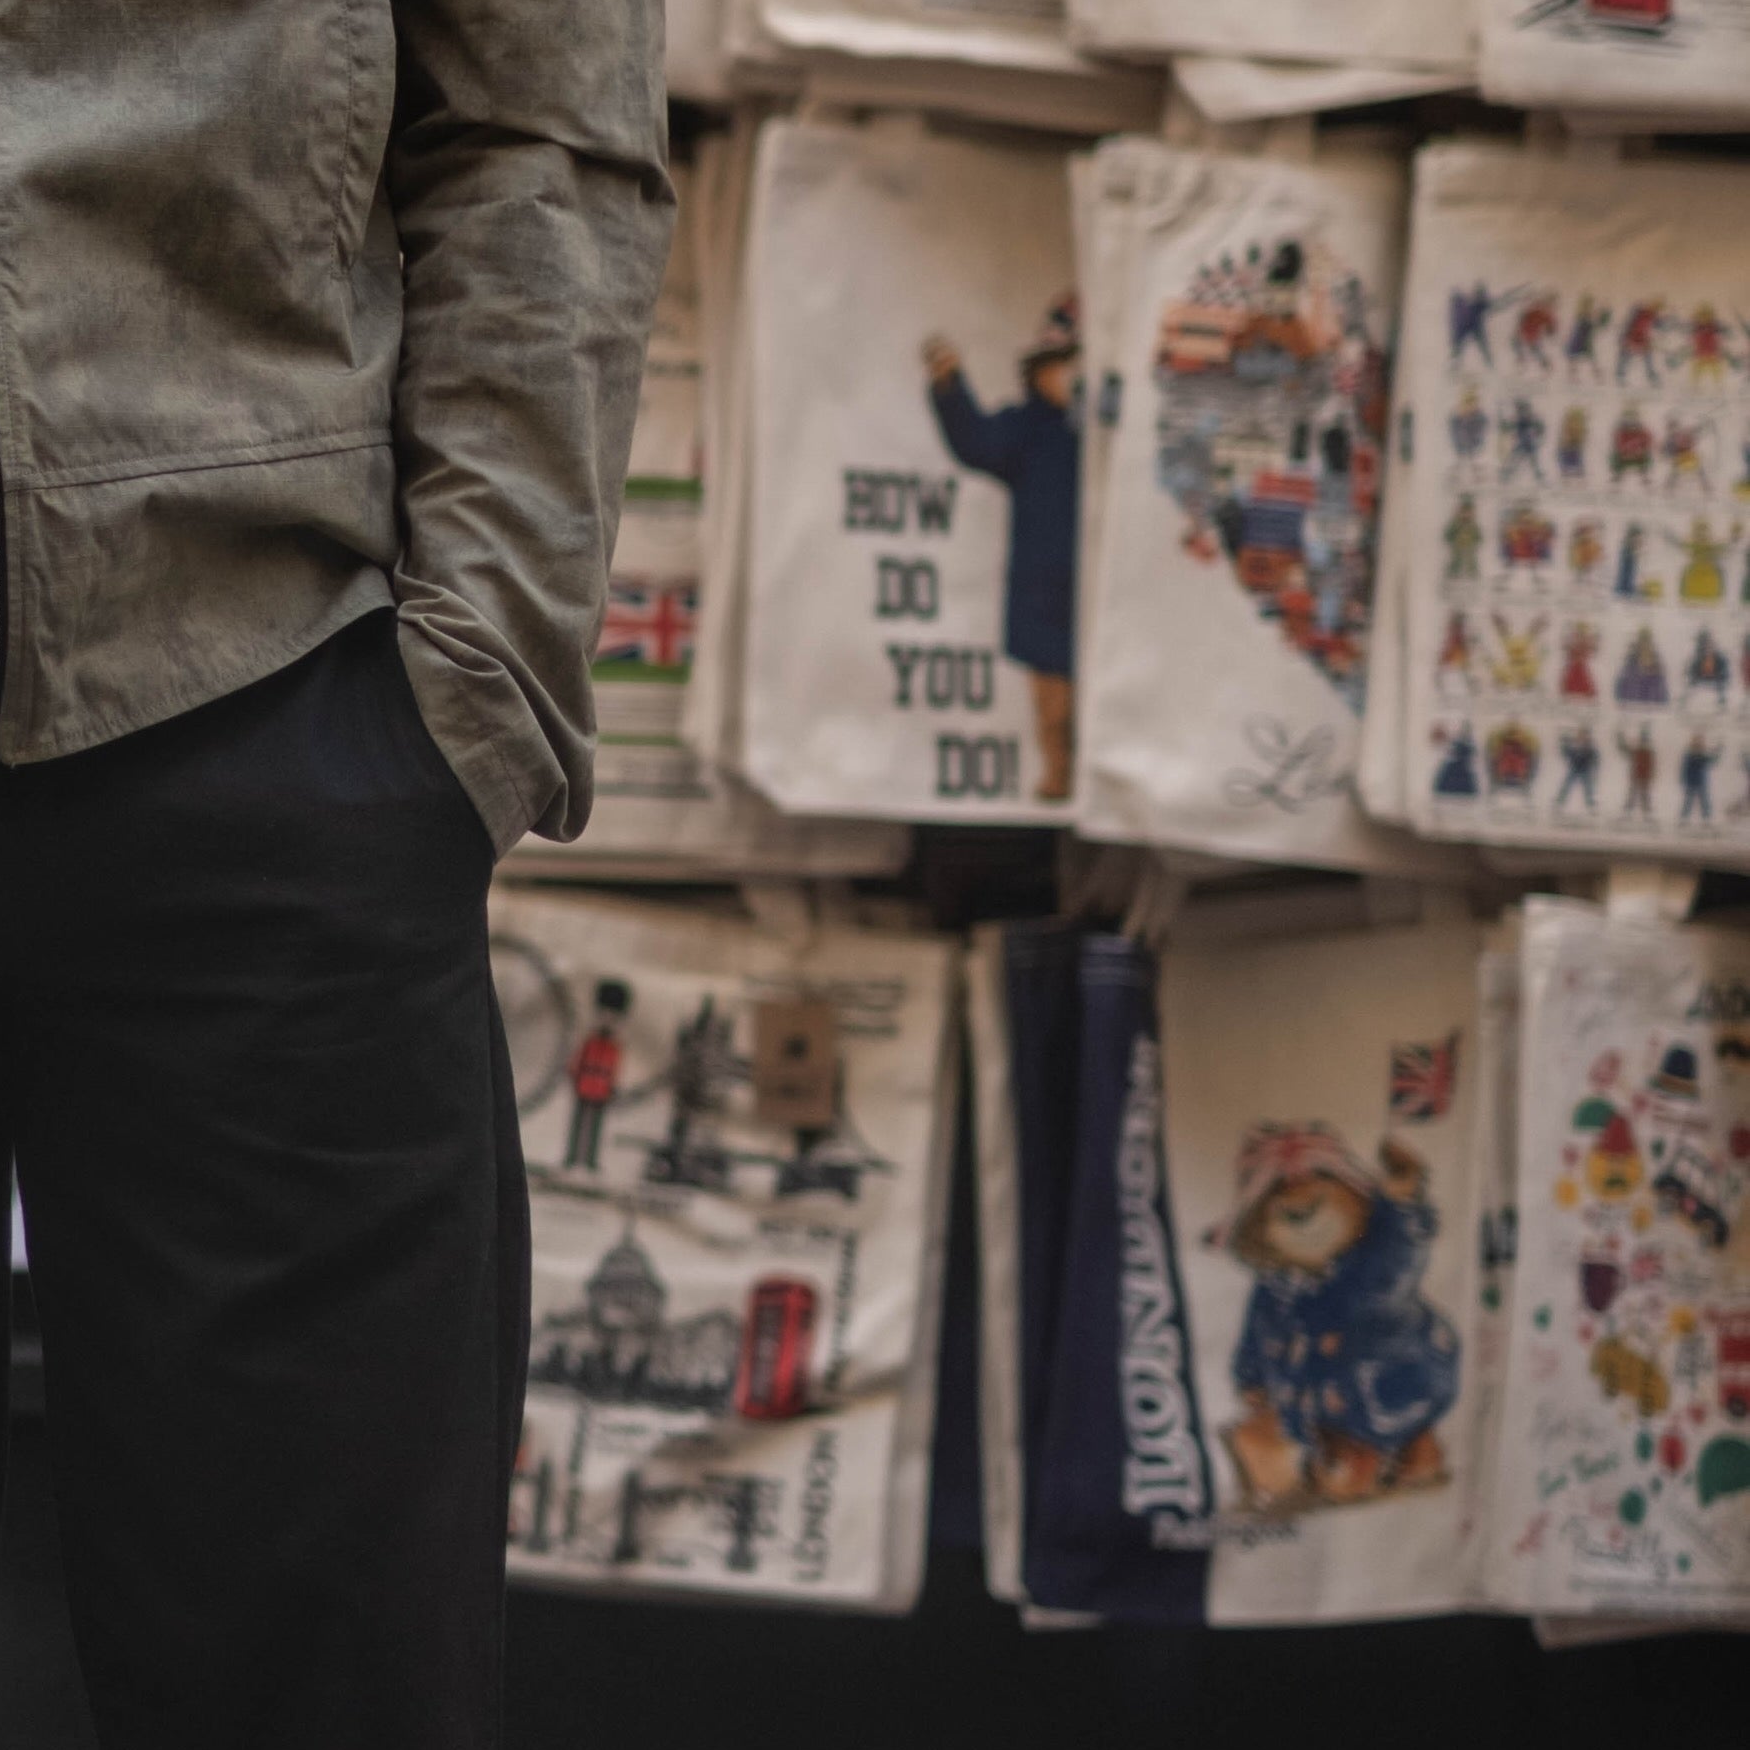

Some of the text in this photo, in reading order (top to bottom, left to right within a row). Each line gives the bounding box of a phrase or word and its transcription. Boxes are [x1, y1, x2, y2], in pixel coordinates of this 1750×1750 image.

[844, 469, 956, 532] HOW
[876, 559, 938, 620] DO
[886, 645, 993, 709] YOU
[937, 735, 1020, 798] DO!
